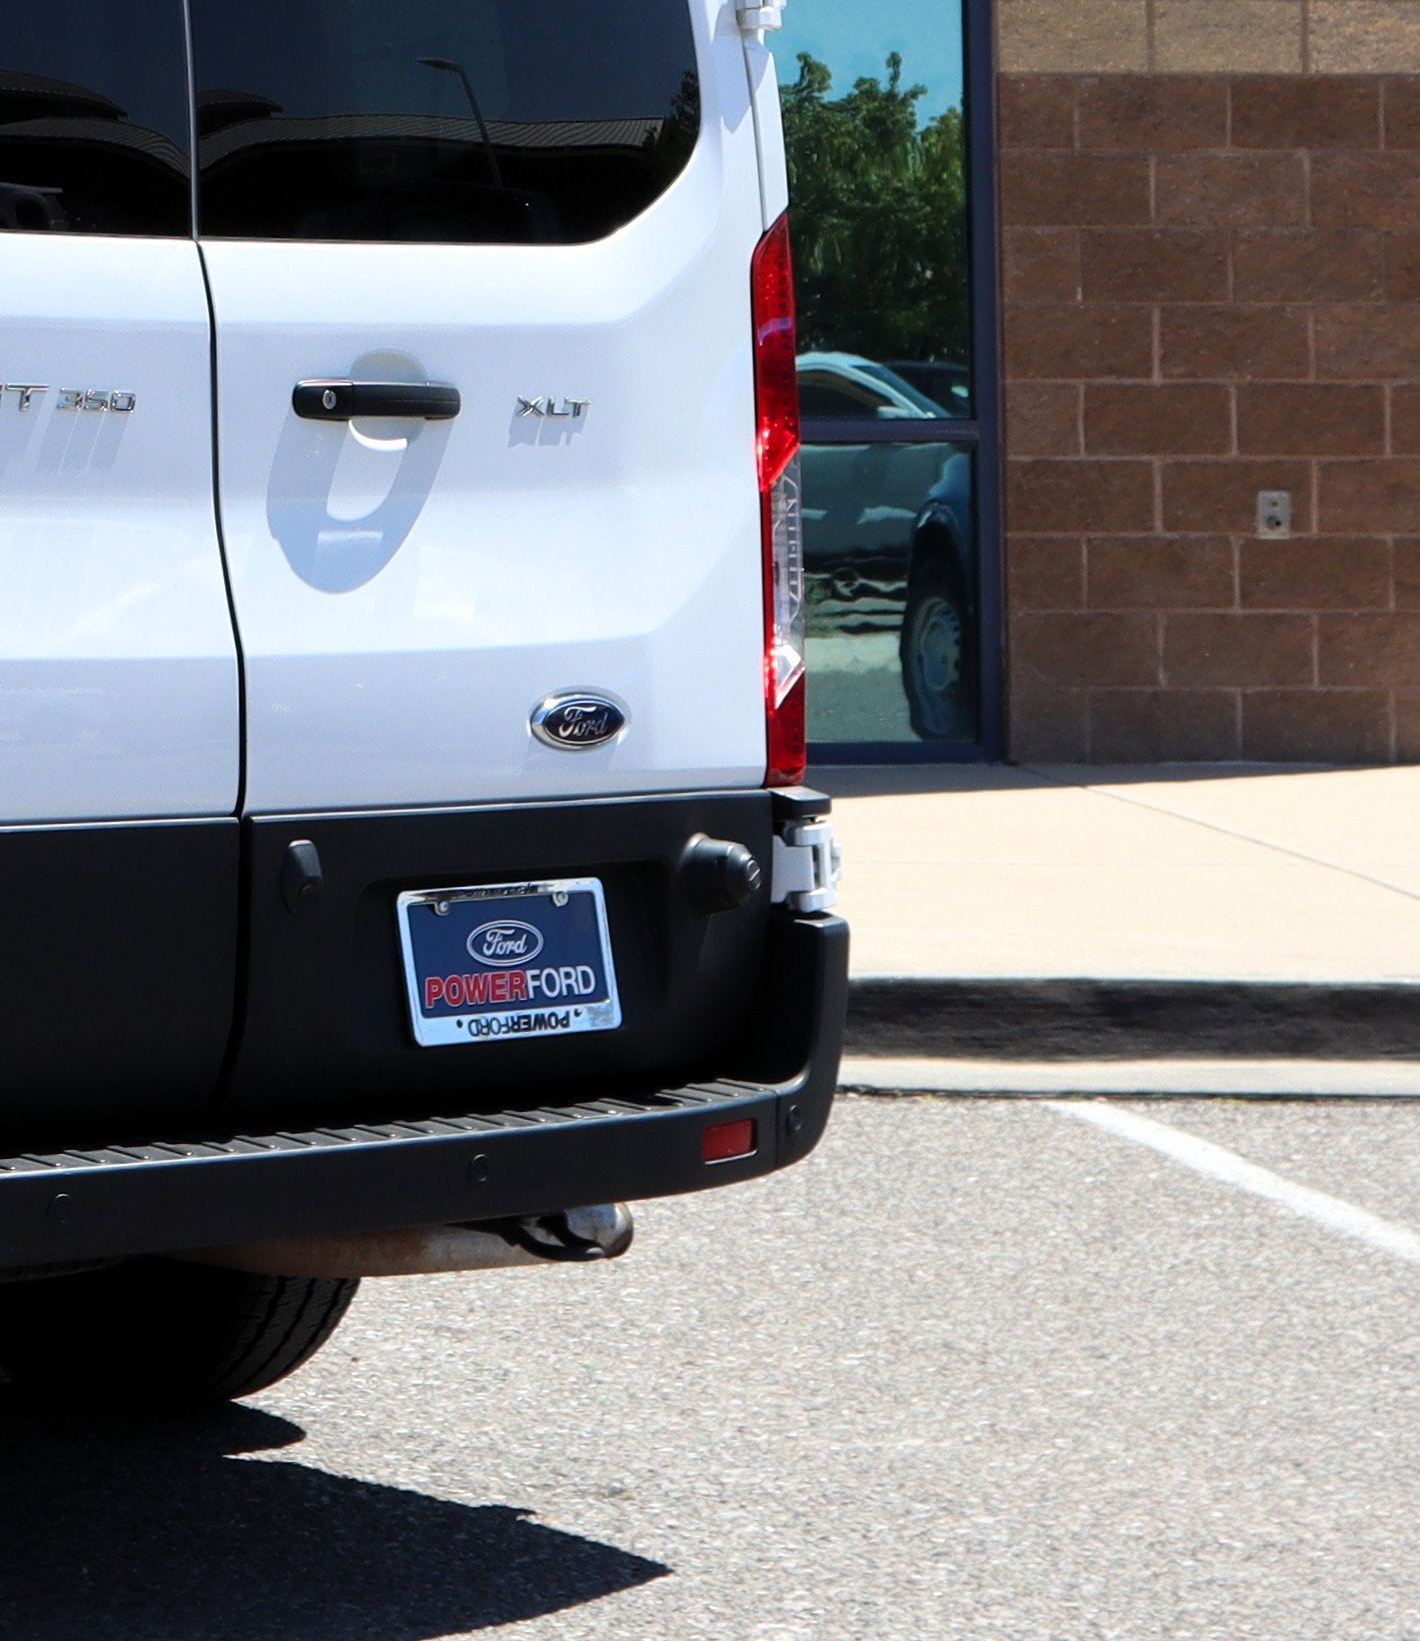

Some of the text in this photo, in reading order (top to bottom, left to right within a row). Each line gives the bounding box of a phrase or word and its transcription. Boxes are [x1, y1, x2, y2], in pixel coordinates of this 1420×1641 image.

[57, 387, 137, 413] 350
[516, 394, 591, 418] XLT
[559, 706, 608, 737] Ford
[482, 928, 529, 956] Ford
[425, 965, 596, 1009] POWERFORD
[468, 1010, 571, 1037] POWERFORD
